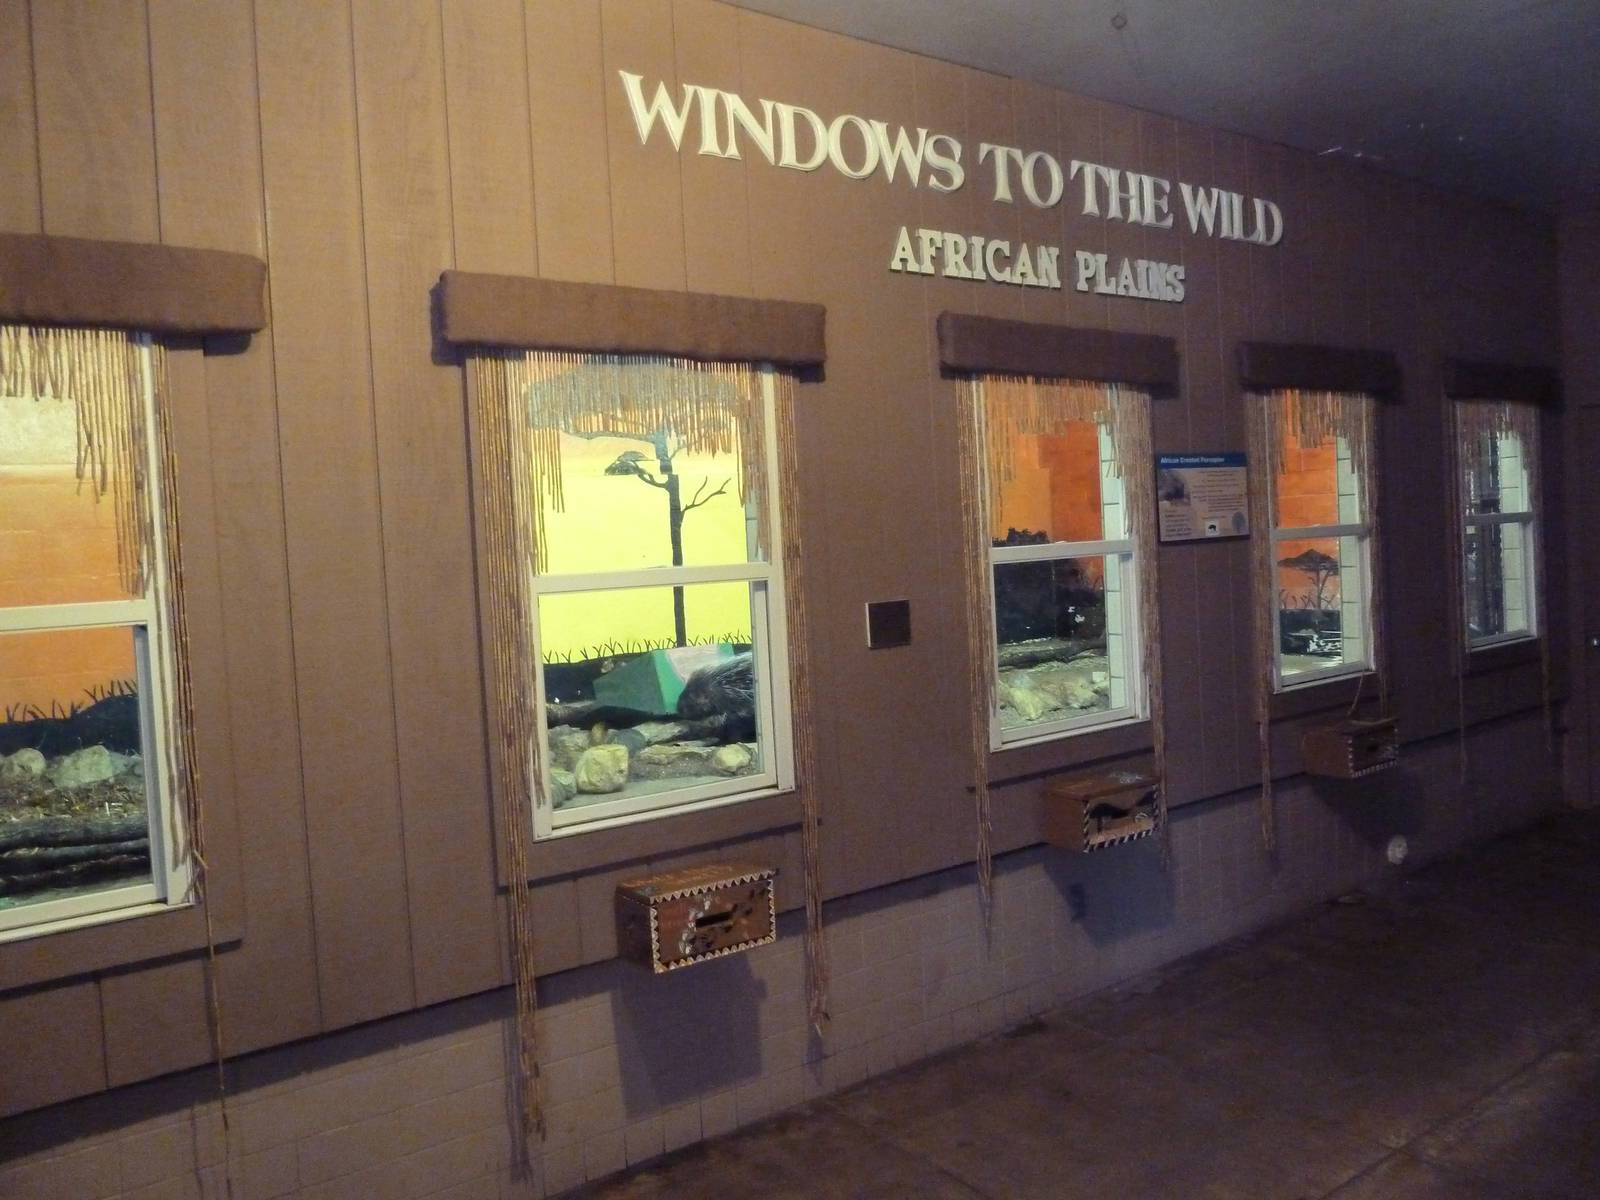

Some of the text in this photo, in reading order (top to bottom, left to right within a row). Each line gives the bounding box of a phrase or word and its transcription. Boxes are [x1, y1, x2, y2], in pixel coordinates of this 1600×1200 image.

[618, 70, 1282, 246] WINDOWS TO THE WILD
[889, 226, 1185, 302] AFRICAN PLAINS
